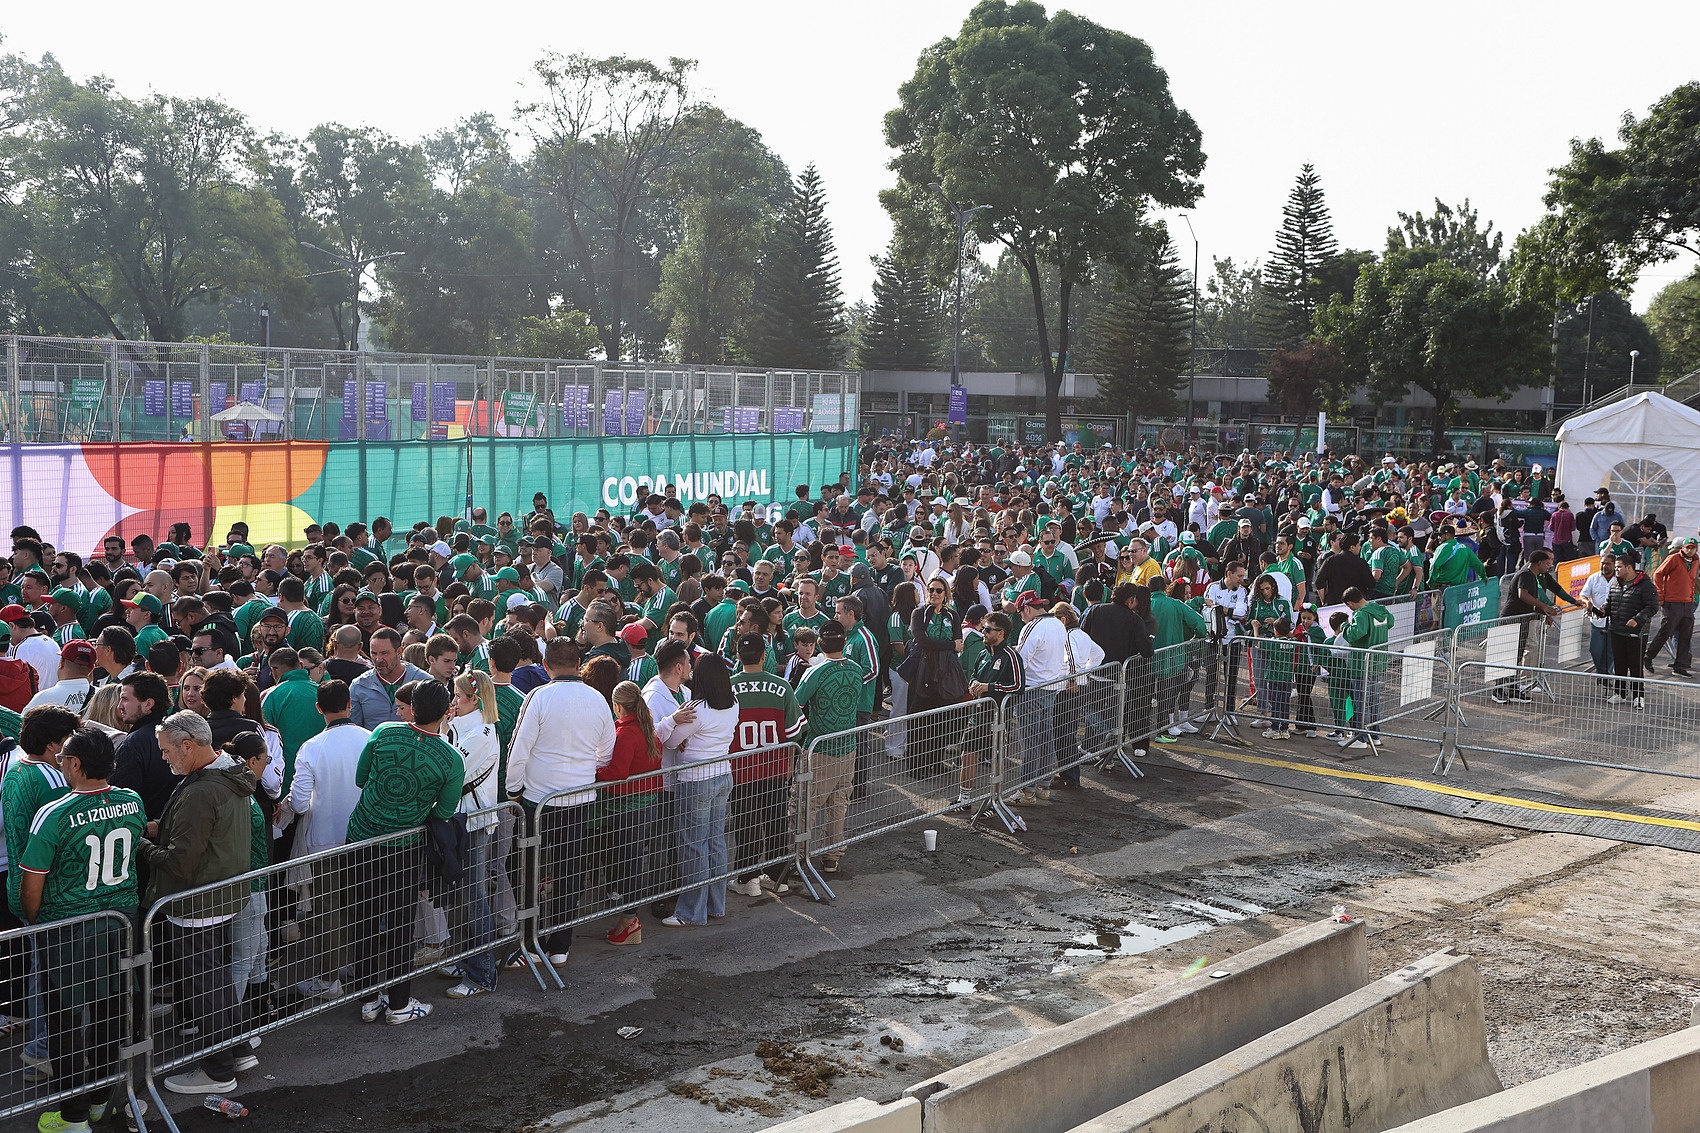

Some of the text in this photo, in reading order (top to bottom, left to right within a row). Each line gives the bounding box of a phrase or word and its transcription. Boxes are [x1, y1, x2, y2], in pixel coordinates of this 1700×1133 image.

[1086, 422, 1113, 431] Coppel
[602, 469, 771, 507] COPA MUNDIAL
[1458, 596, 1488, 614] WORLD CUP
[1463, 611, 1481, 624] 2026
[739, 720, 779, 749] 00
[85, 827, 132, 891] 10
